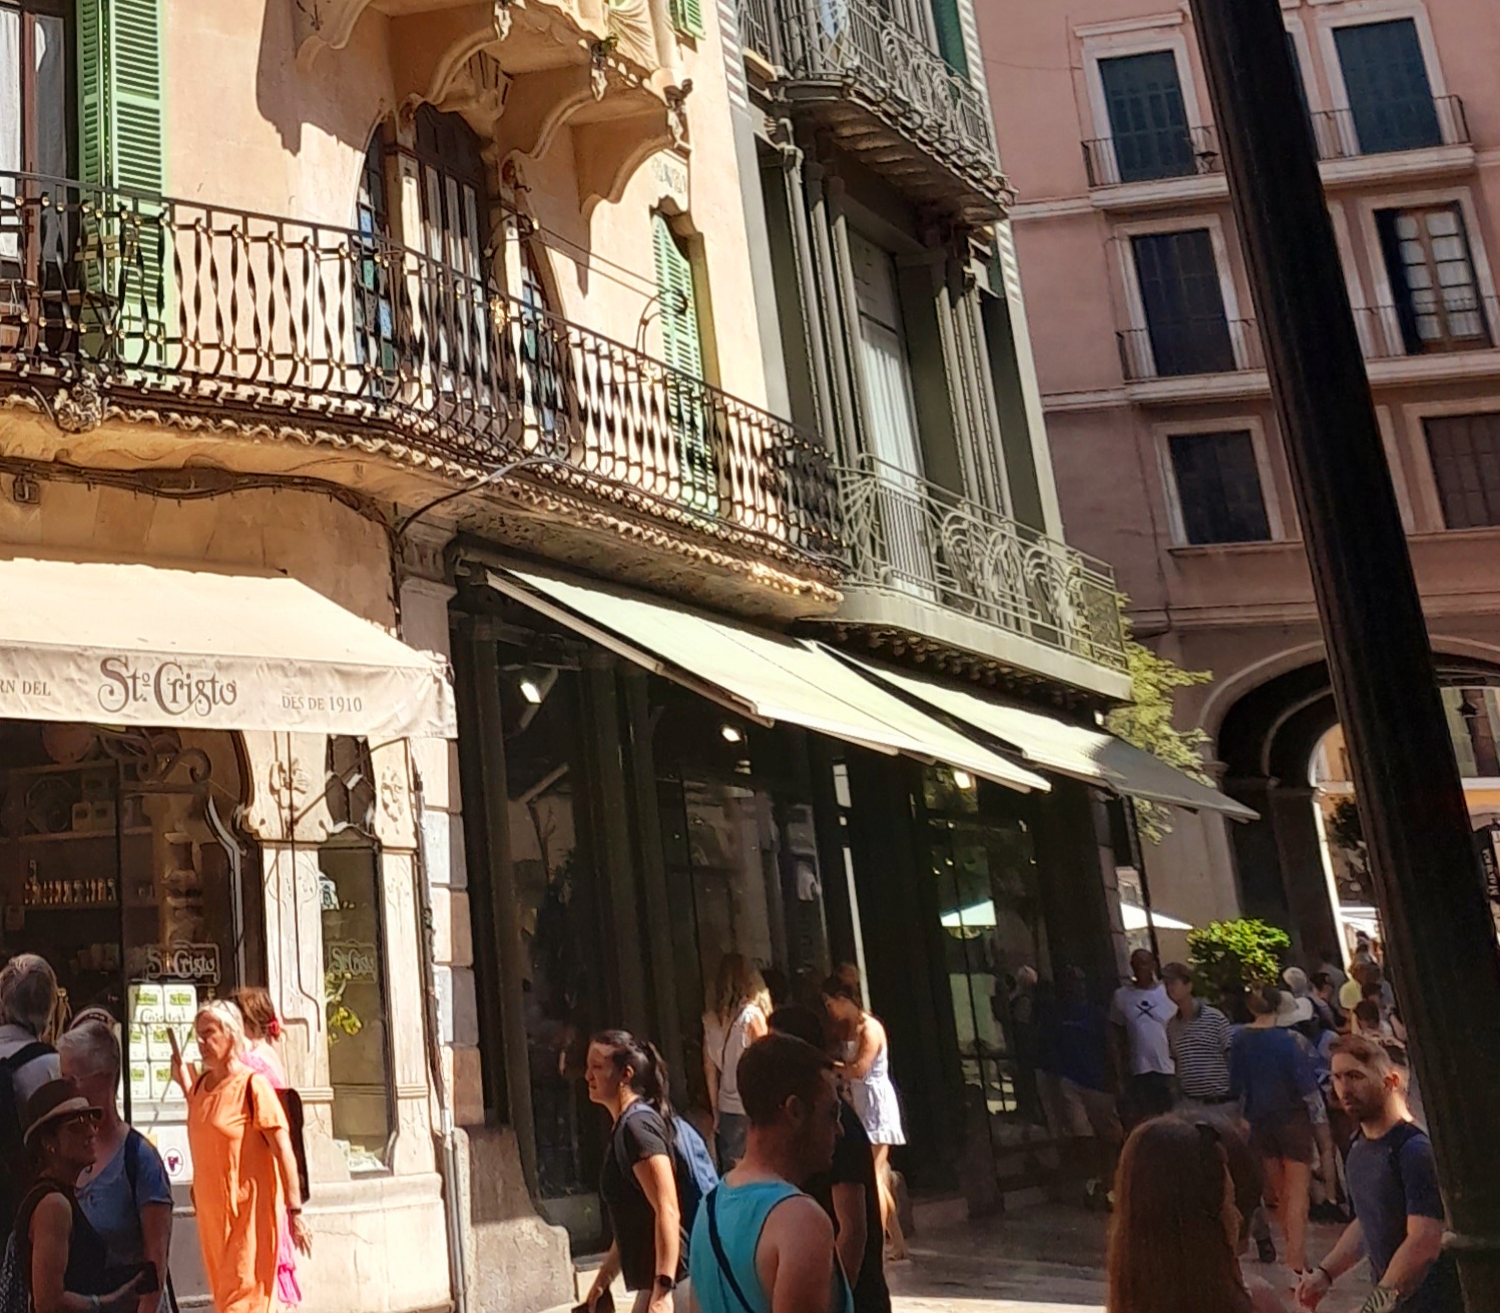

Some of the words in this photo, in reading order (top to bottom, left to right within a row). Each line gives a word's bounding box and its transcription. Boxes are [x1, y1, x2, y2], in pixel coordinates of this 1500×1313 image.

[21, 680, 51, 697] DEL
[153, 661, 238, 717] Cristo
[282, 695, 304, 710] DES
[308, 697, 325, 711] DE
[329, 696, 363, 713] 1910
[173, 950, 215, 979] Cristo
